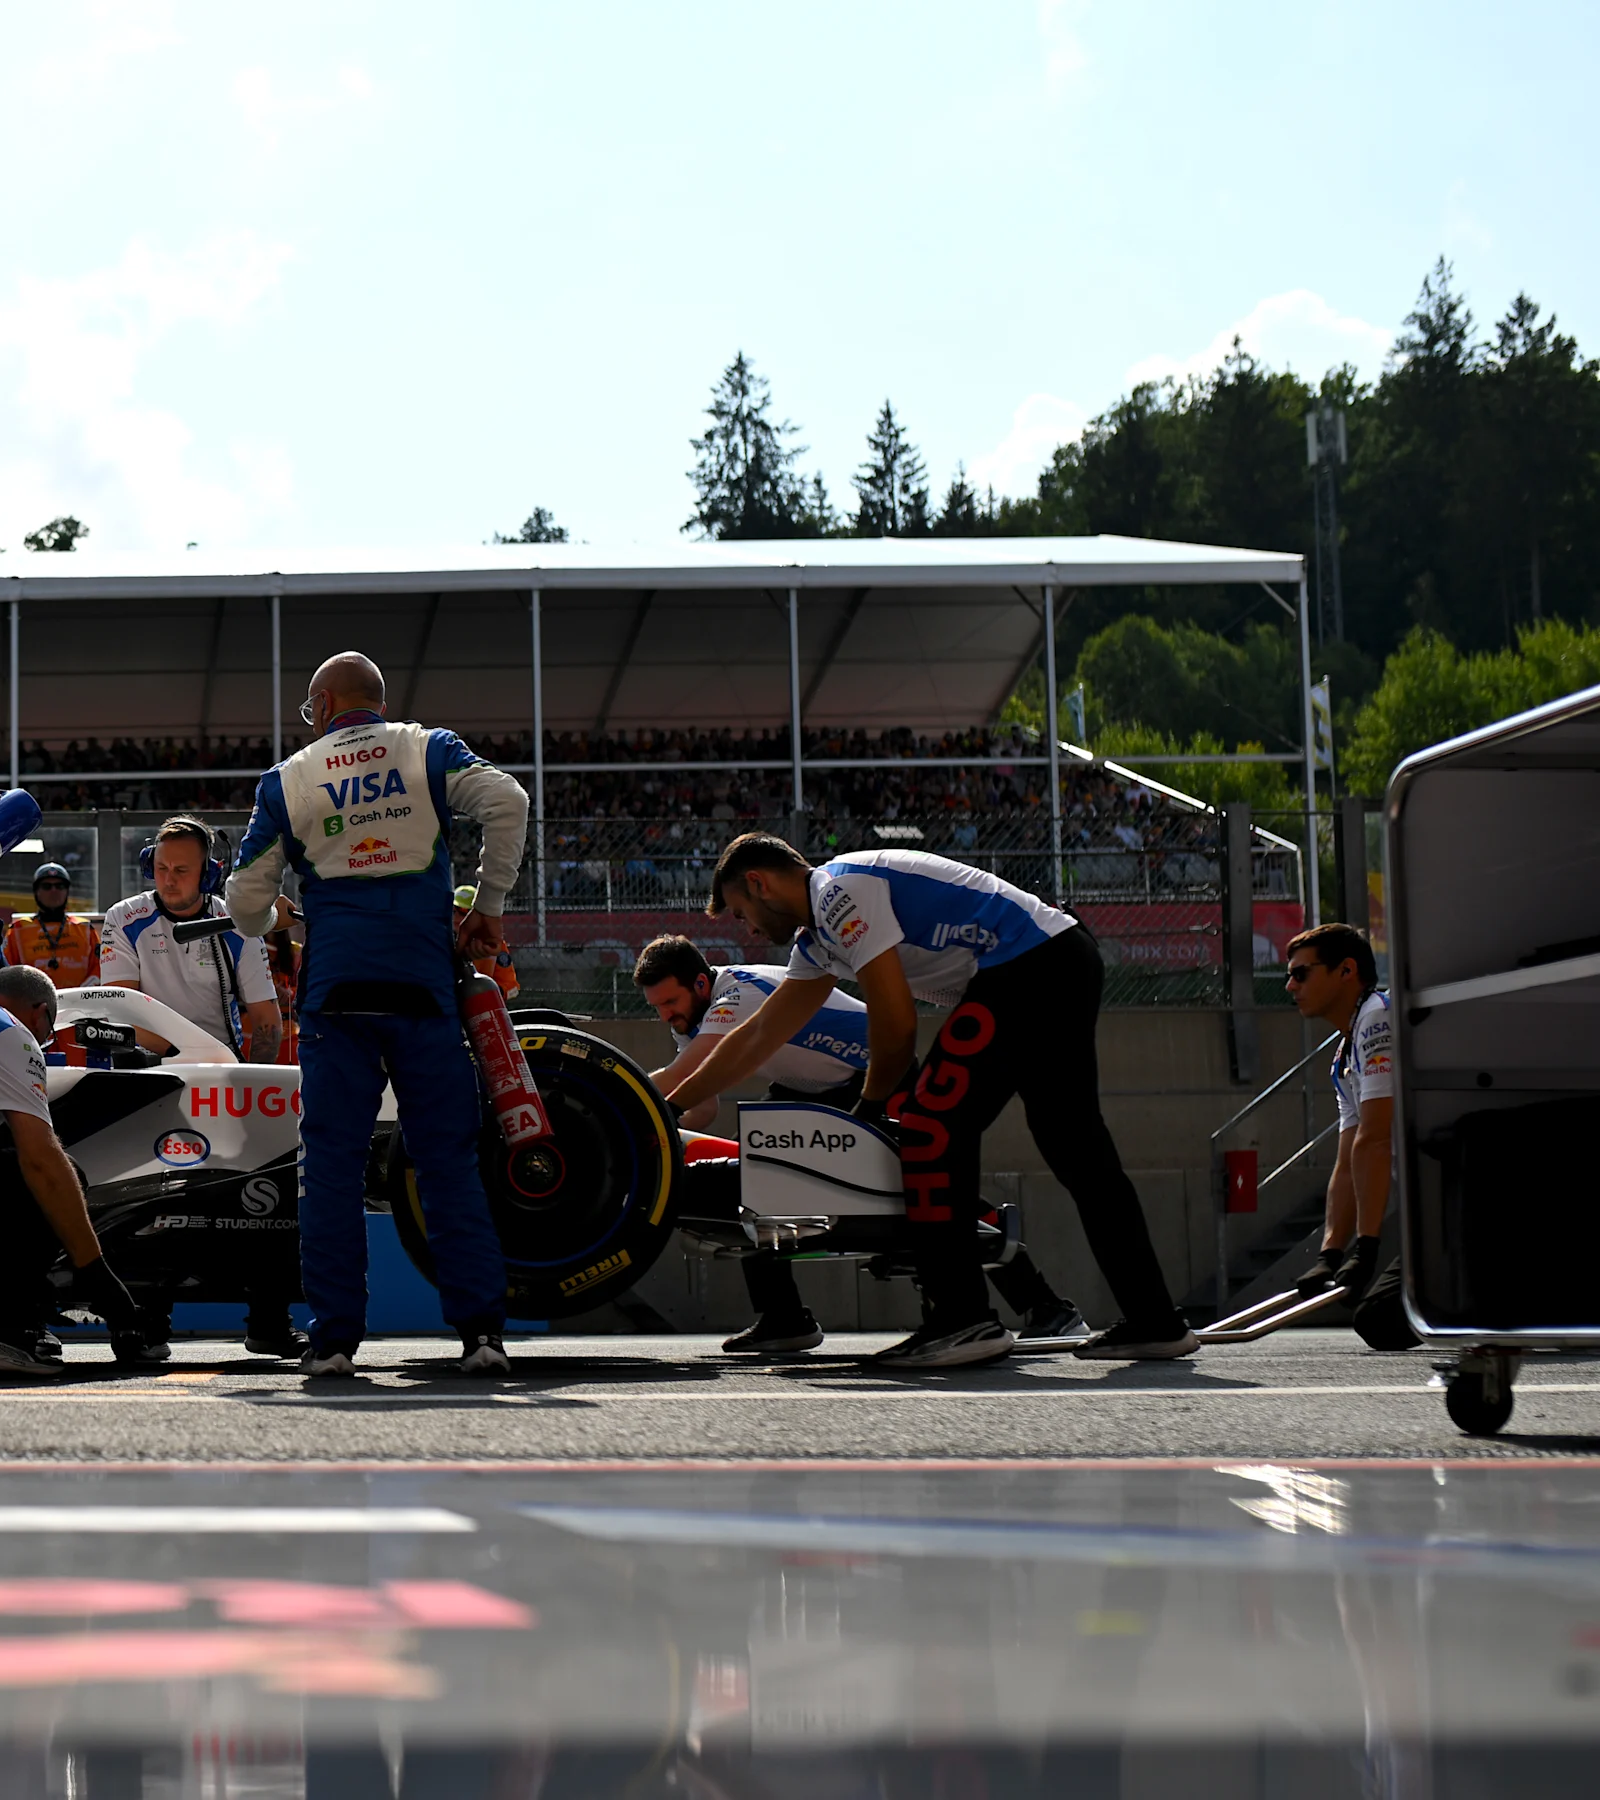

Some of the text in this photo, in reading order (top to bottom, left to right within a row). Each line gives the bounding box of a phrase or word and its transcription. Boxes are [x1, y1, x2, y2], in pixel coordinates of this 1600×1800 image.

[333, 735, 376, 748] HONDA
[326, 746, 387, 770] HUGO
[317, 768, 407, 810] VISA
[349, 806, 412, 826] Cash App
[348, 850, 398, 869] Red Bull
[821, 885, 843, 912] VISA
[124, 906, 148, 920] HUGO
[842, 922, 869, 949] Red Bull
[705, 1015, 737, 1024] Red Bull
[1361, 1021, 1391, 1039] VISA
[1365, 1064, 1392, 1076] Red Bu
[903, 1000, 996, 1223] HUGO
[163, 1138, 203, 1155] Esso
[747, 1130, 856, 1152] Cash App
[558, 1249, 632, 1297] PIRELLI
